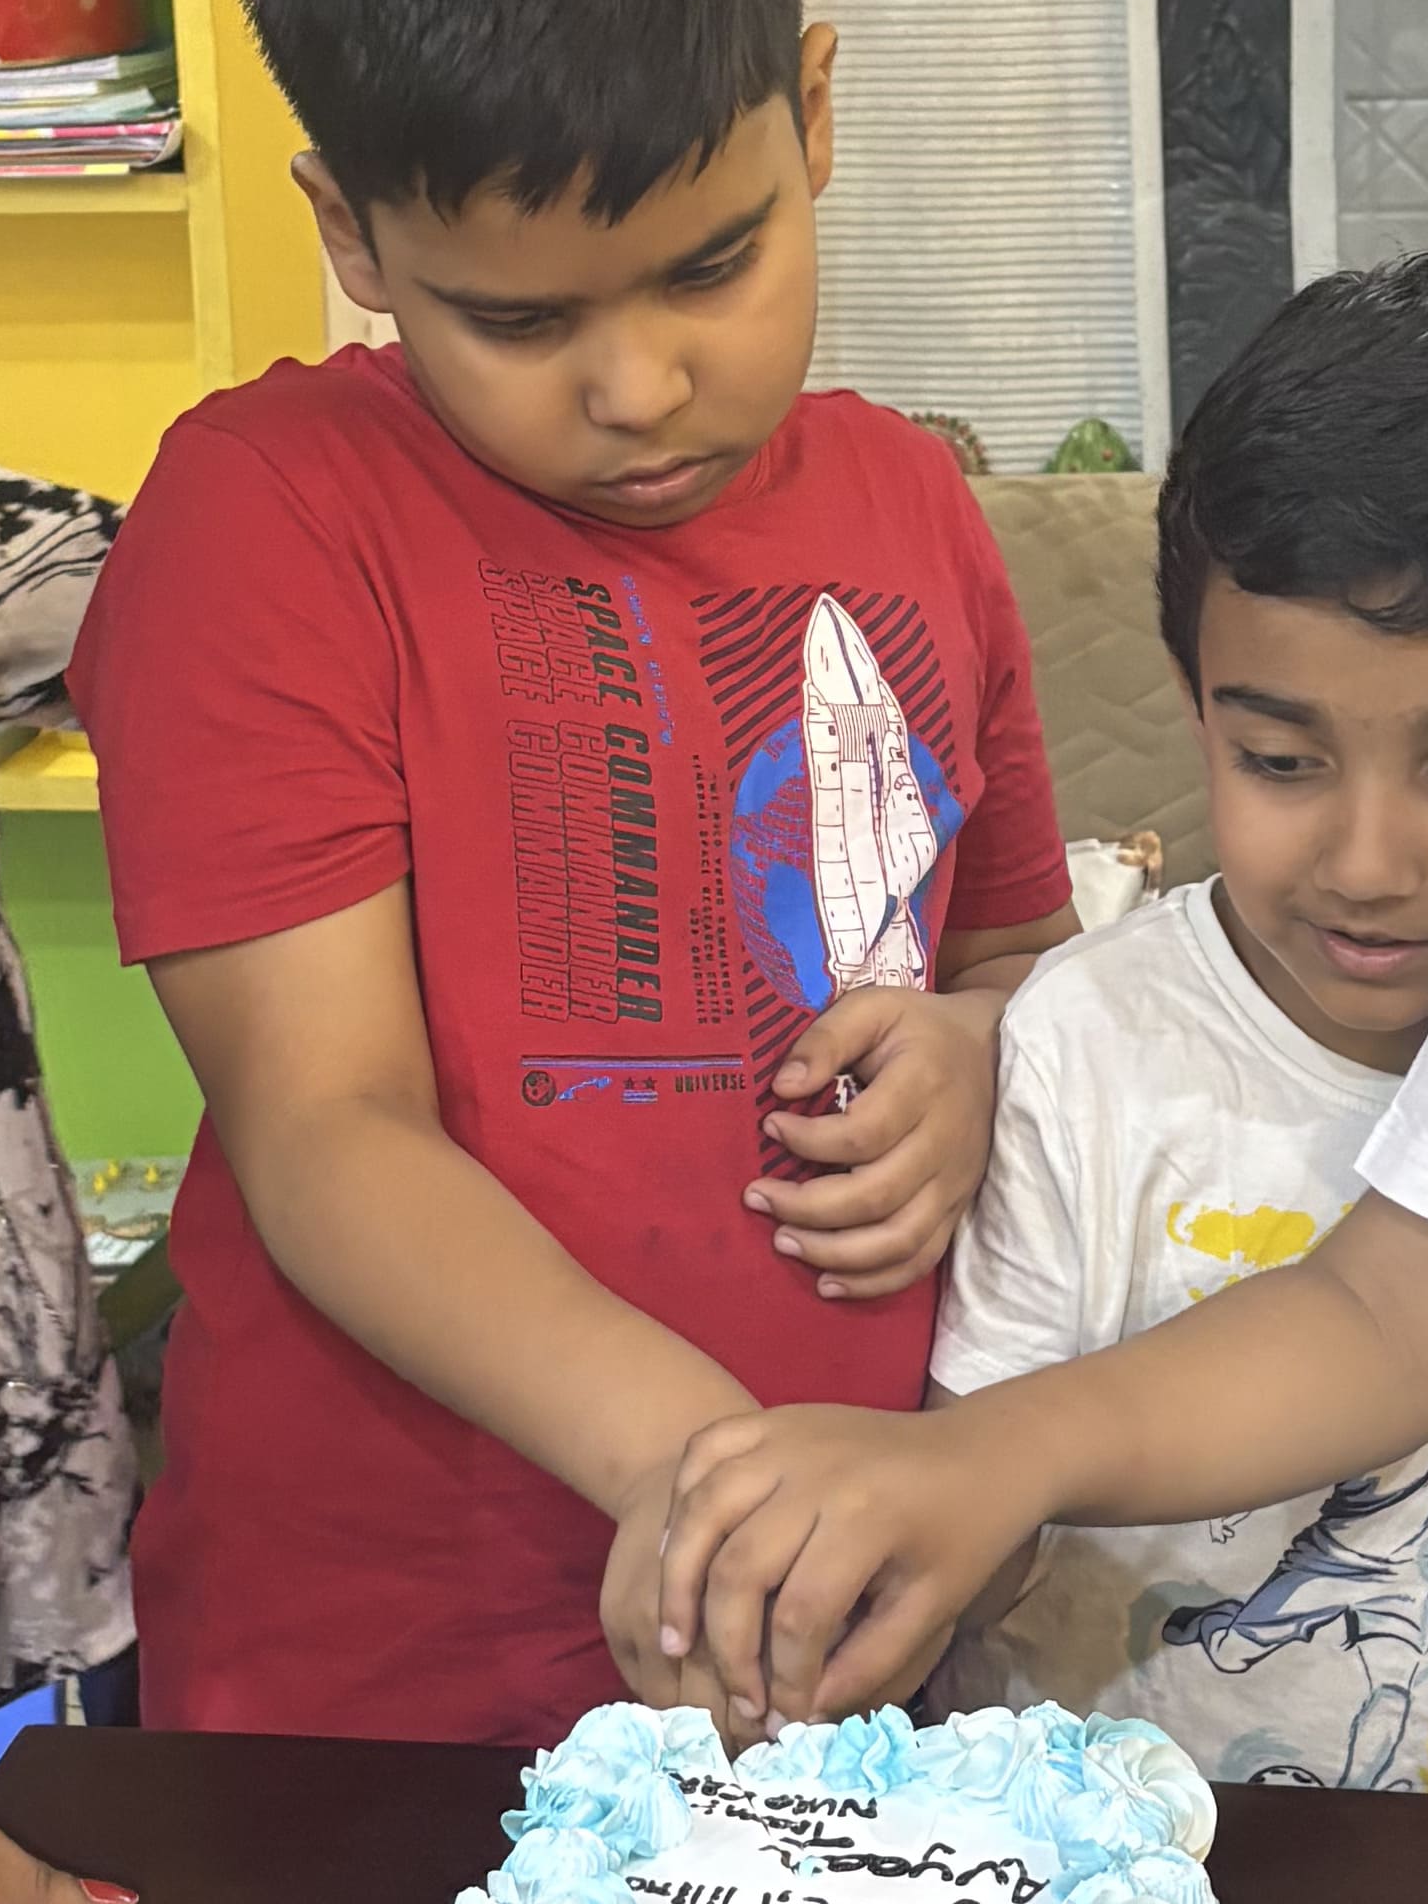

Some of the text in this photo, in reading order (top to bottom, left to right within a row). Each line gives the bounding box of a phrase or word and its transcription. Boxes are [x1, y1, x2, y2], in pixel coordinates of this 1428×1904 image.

[477, 558, 571, 1024] SPACE COMMANDER
[521, 569, 619, 1025] SPACE COMMANDER
[565, 576, 644, 708] SPACE
[605, 722, 663, 1024] COMMANDER
[674, 1072, 747, 1094] UNIVERSE
